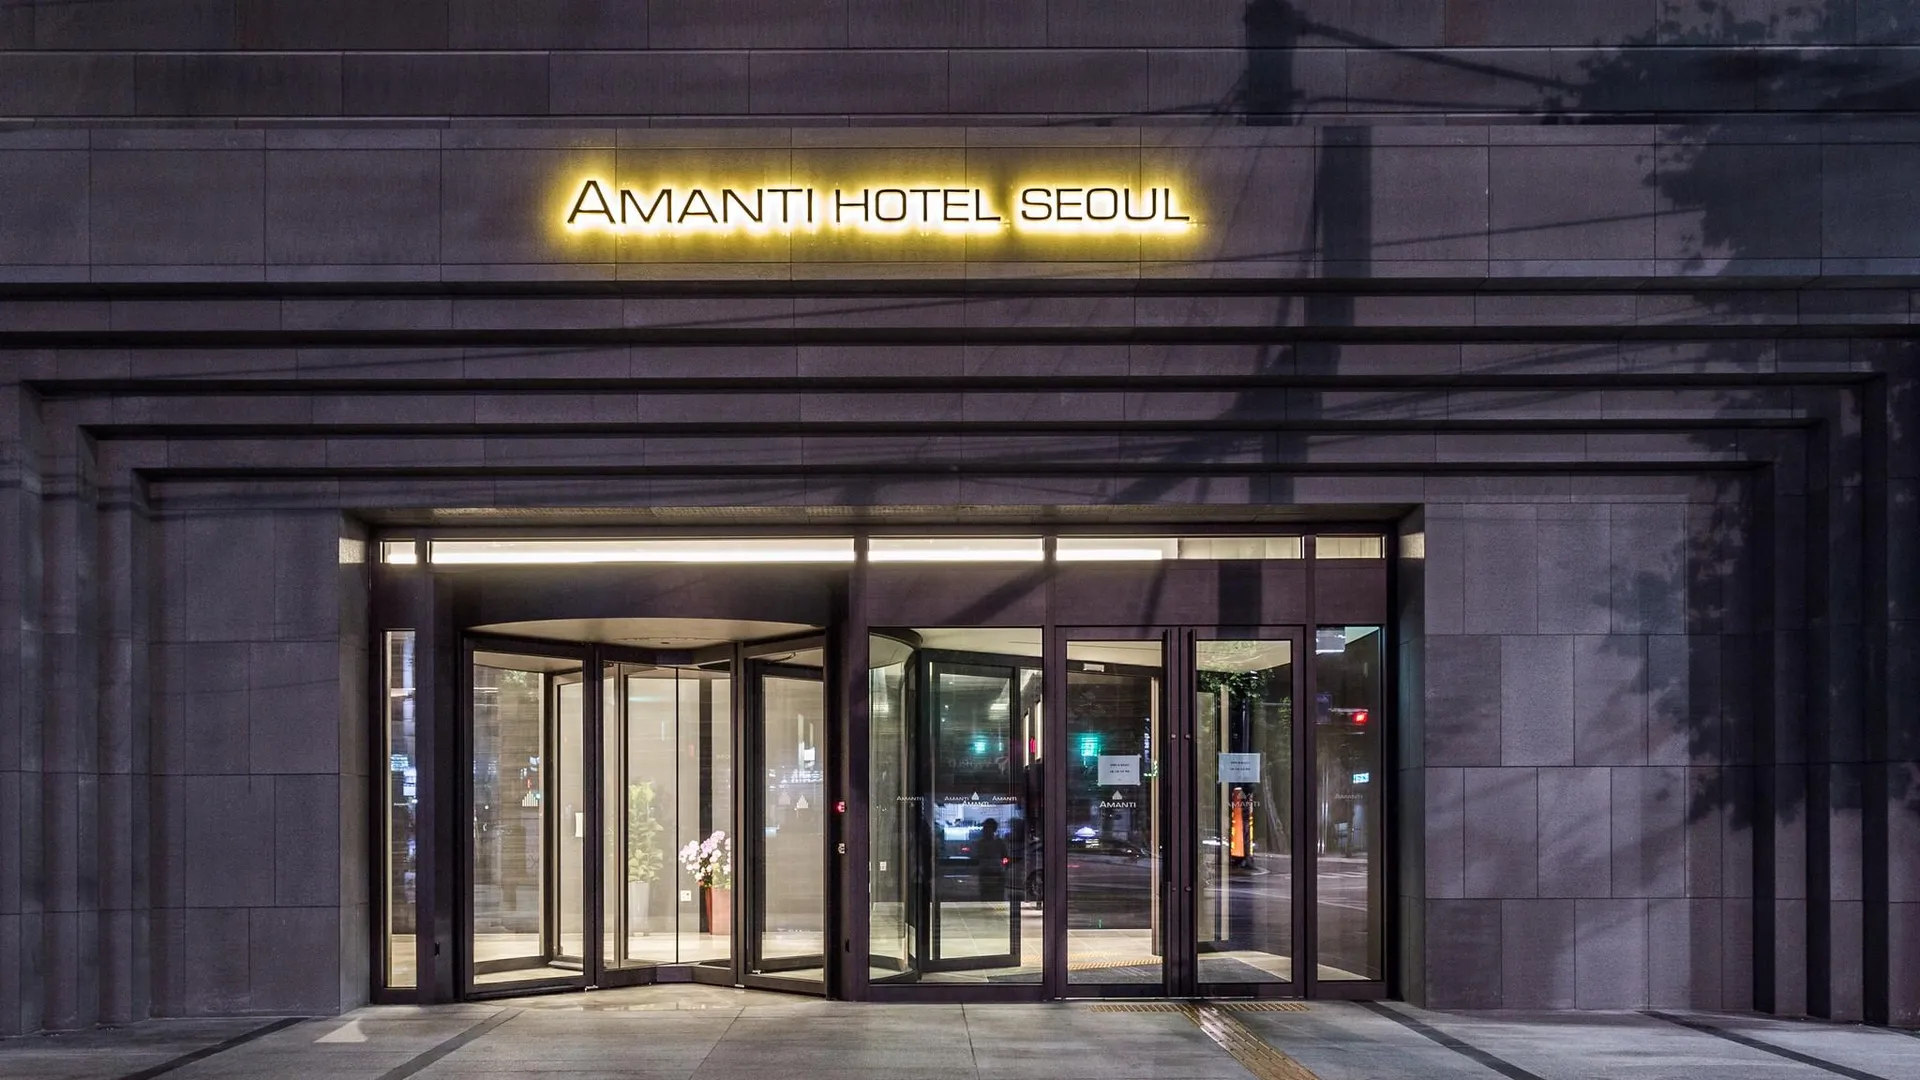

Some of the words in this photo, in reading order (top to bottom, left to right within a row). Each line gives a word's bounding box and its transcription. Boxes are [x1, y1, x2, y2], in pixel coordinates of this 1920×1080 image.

[566, 179, 814, 225] AMANTI
[833, 187, 1002, 222] HOTEL
[1020, 187, 1191, 222] SEOUL
[1099, 800, 1137, 808] AMANTI
